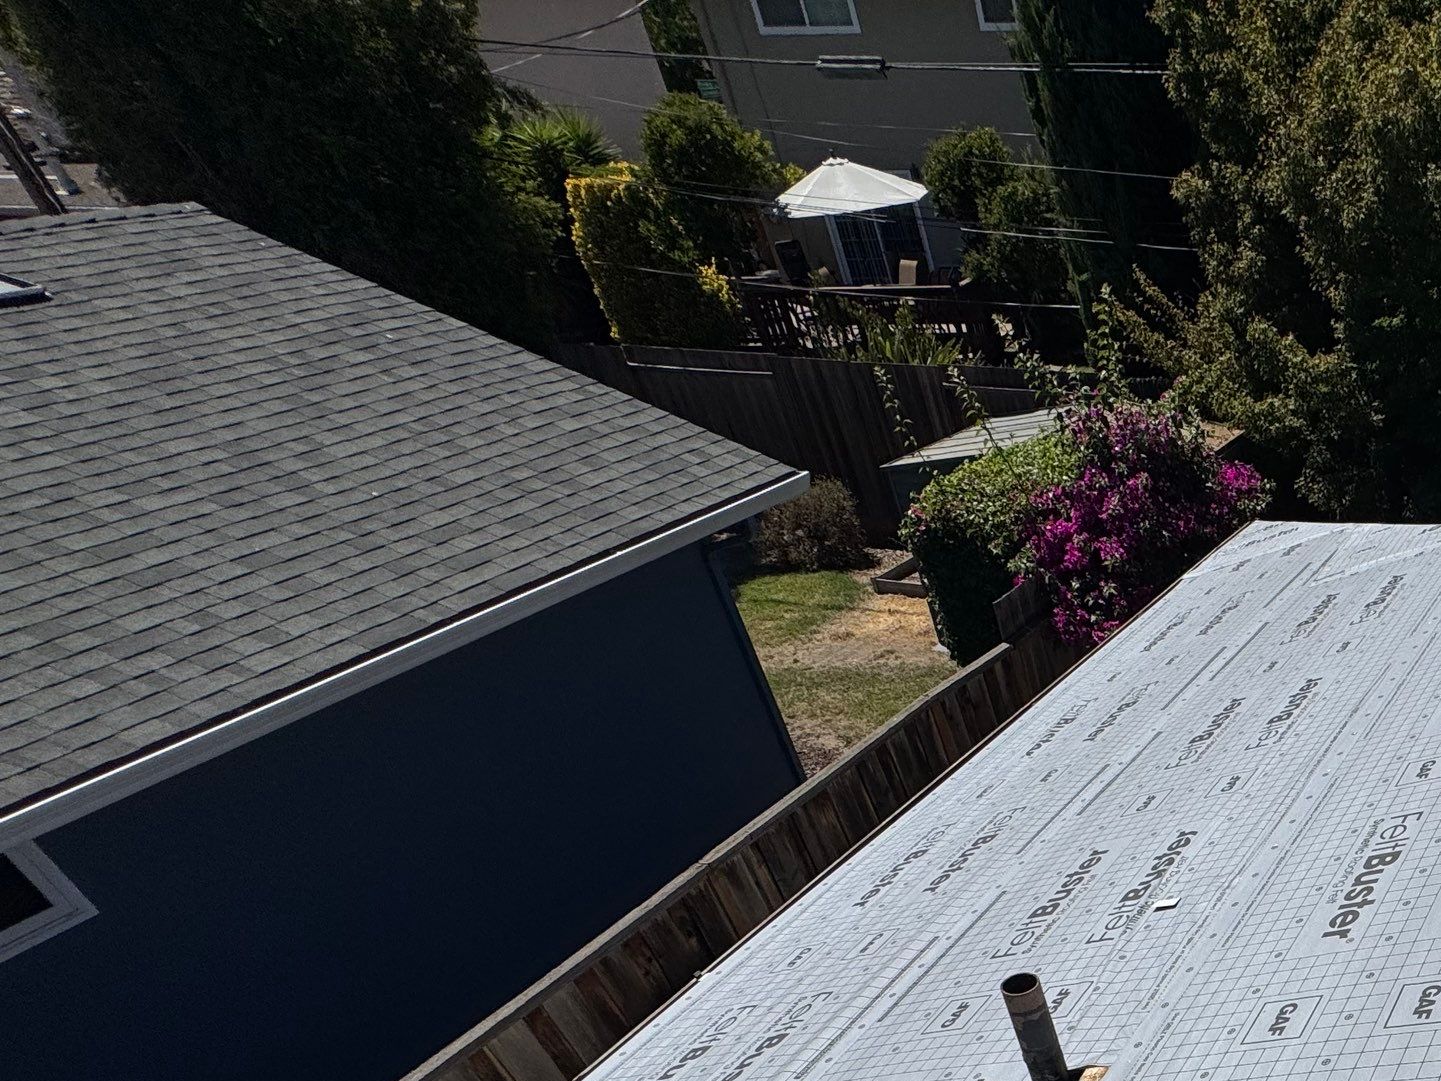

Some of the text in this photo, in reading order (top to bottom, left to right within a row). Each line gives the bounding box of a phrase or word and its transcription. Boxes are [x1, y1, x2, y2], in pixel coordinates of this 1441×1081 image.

[1164, 697, 1246, 770] FeltBuster
[1245, 677, 1323, 751] FeltBuster
[1220, 774, 1242, 793] GAF
[1416, 759, 1437, 780] GAF
[990, 850, 1109, 960] FeltBuster
[1085, 829, 1198, 945] FeltBuster
[940, 999, 972, 1031] GAF
[1267, 1002, 1300, 1038] GAF
